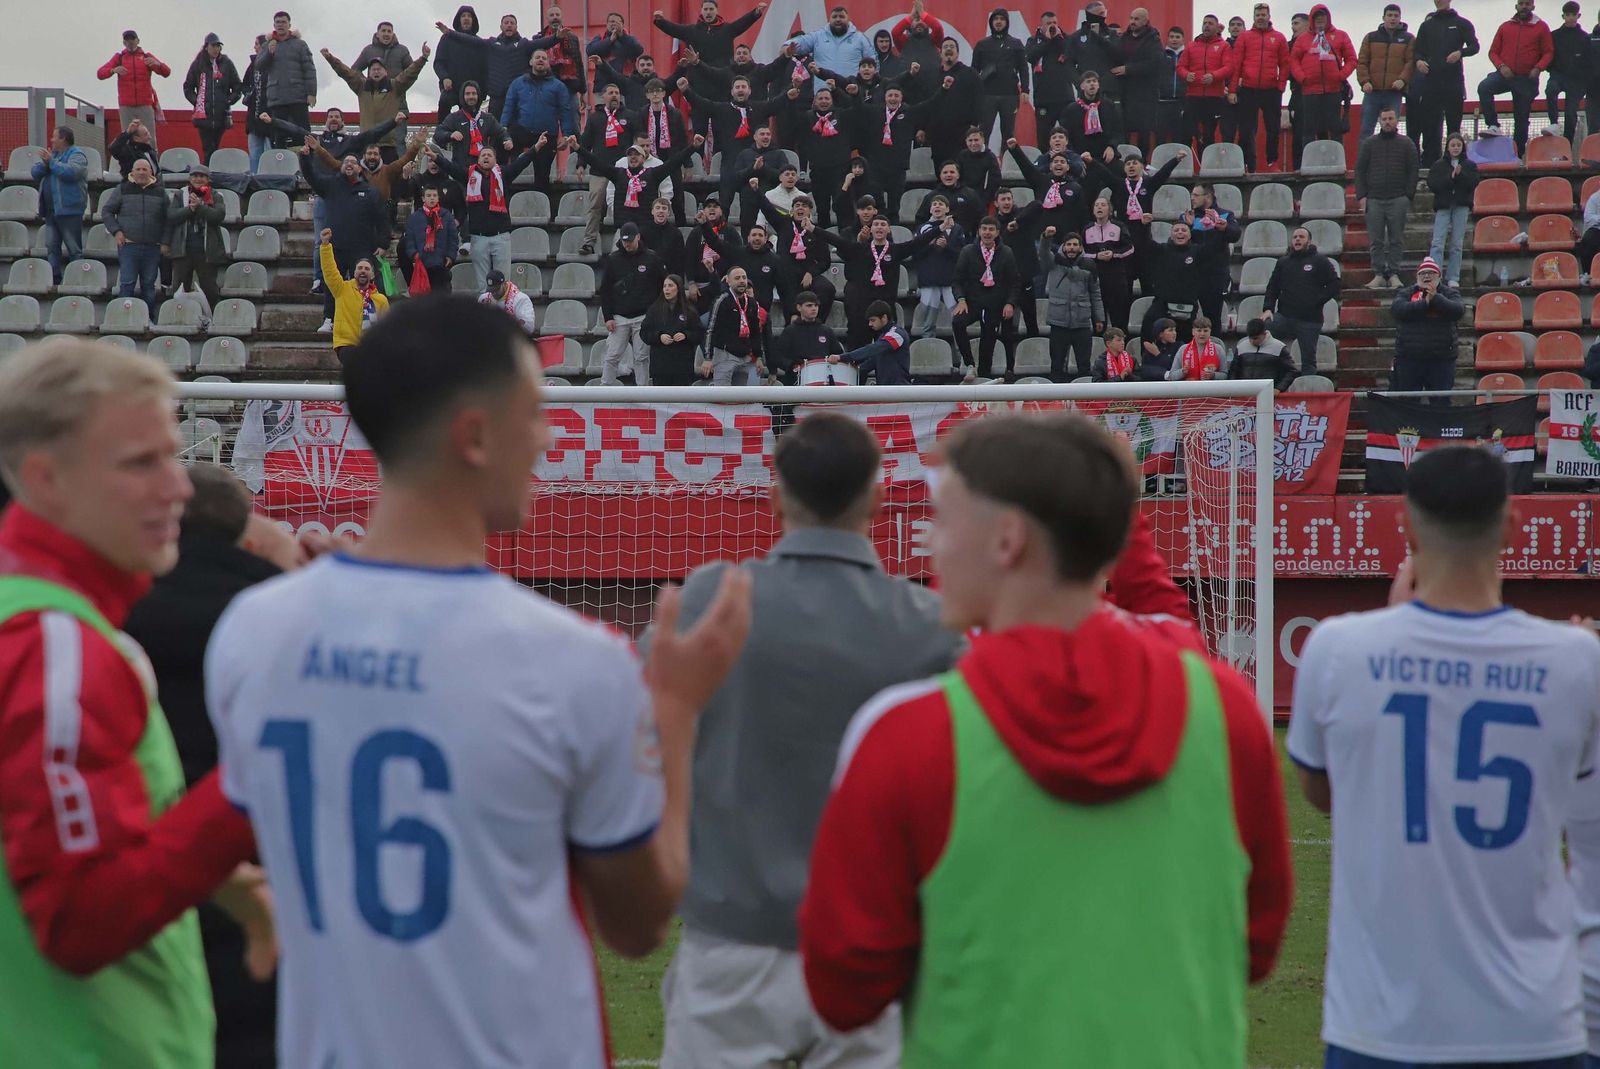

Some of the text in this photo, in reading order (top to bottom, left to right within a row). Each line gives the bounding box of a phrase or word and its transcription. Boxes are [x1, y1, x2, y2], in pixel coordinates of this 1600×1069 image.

[1564, 391, 1594, 411] ACF
[1205, 410, 1329, 442] SOTH
[1561, 425, 1579, 438] 19
[1209, 438, 1325, 468] SPRIT
[1273, 467, 1305, 481] 912
[1274, 556, 1381, 571] endencias
[1497, 556, 1600, 572] endencis
[303, 639, 426, 692] ÁNGEL
[1369, 650, 1548, 693] VÍCTOR RUÍZ
[1383, 692, 1540, 850] 15
[257, 719, 452, 943] 16
